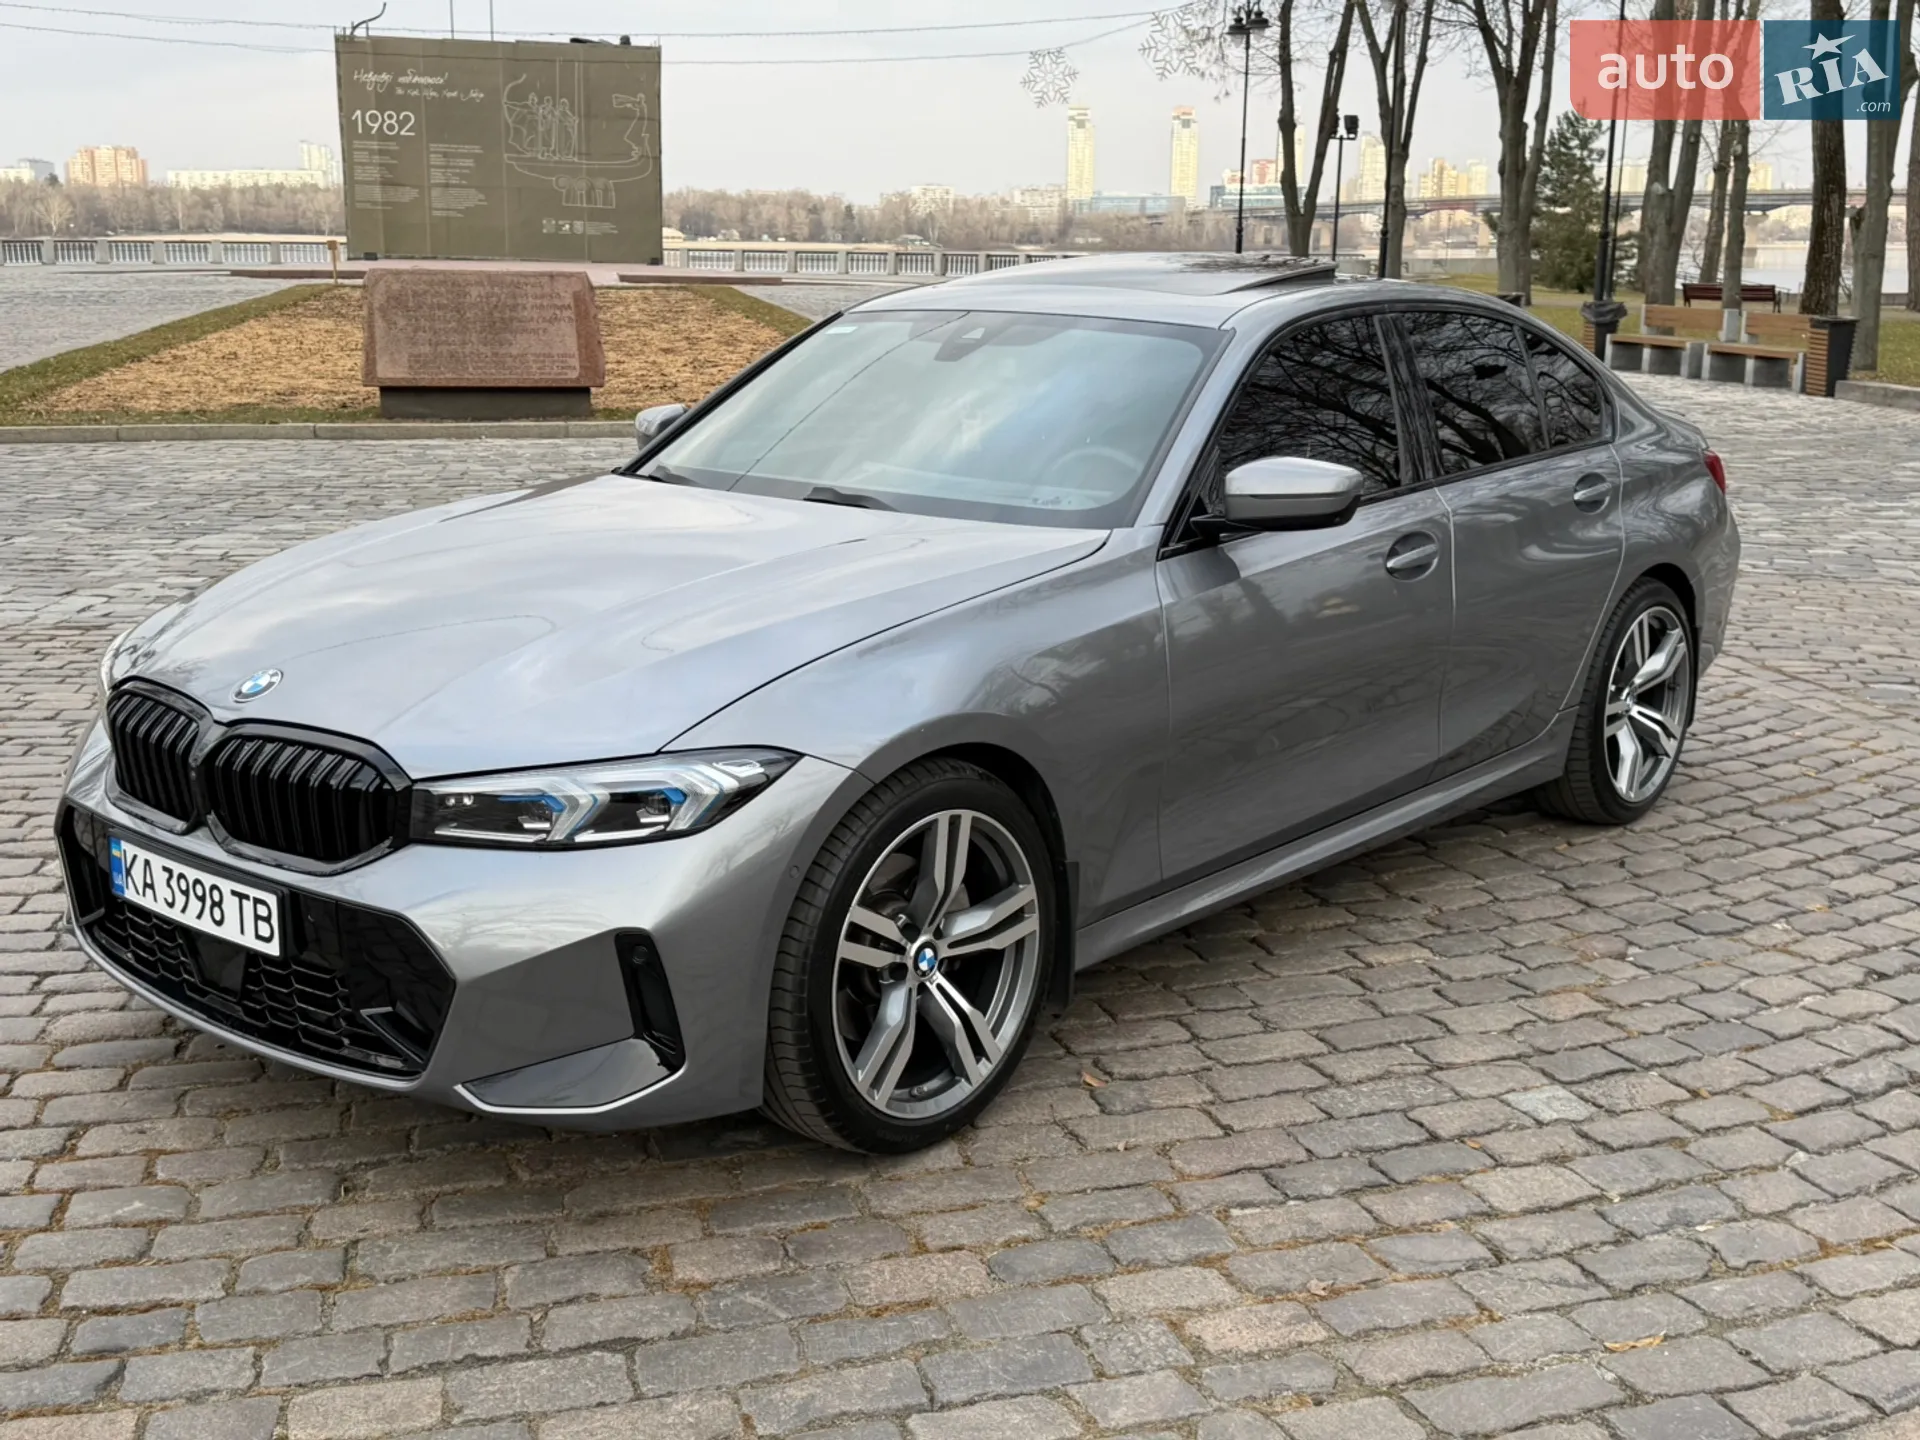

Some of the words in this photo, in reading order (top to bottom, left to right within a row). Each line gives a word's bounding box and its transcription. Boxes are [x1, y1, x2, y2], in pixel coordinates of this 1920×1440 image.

[351, 109, 416, 136] 1982
[123, 849, 157, 903] KA
[161, 865, 225, 928] 3998
[230, 889, 275, 944] TB
